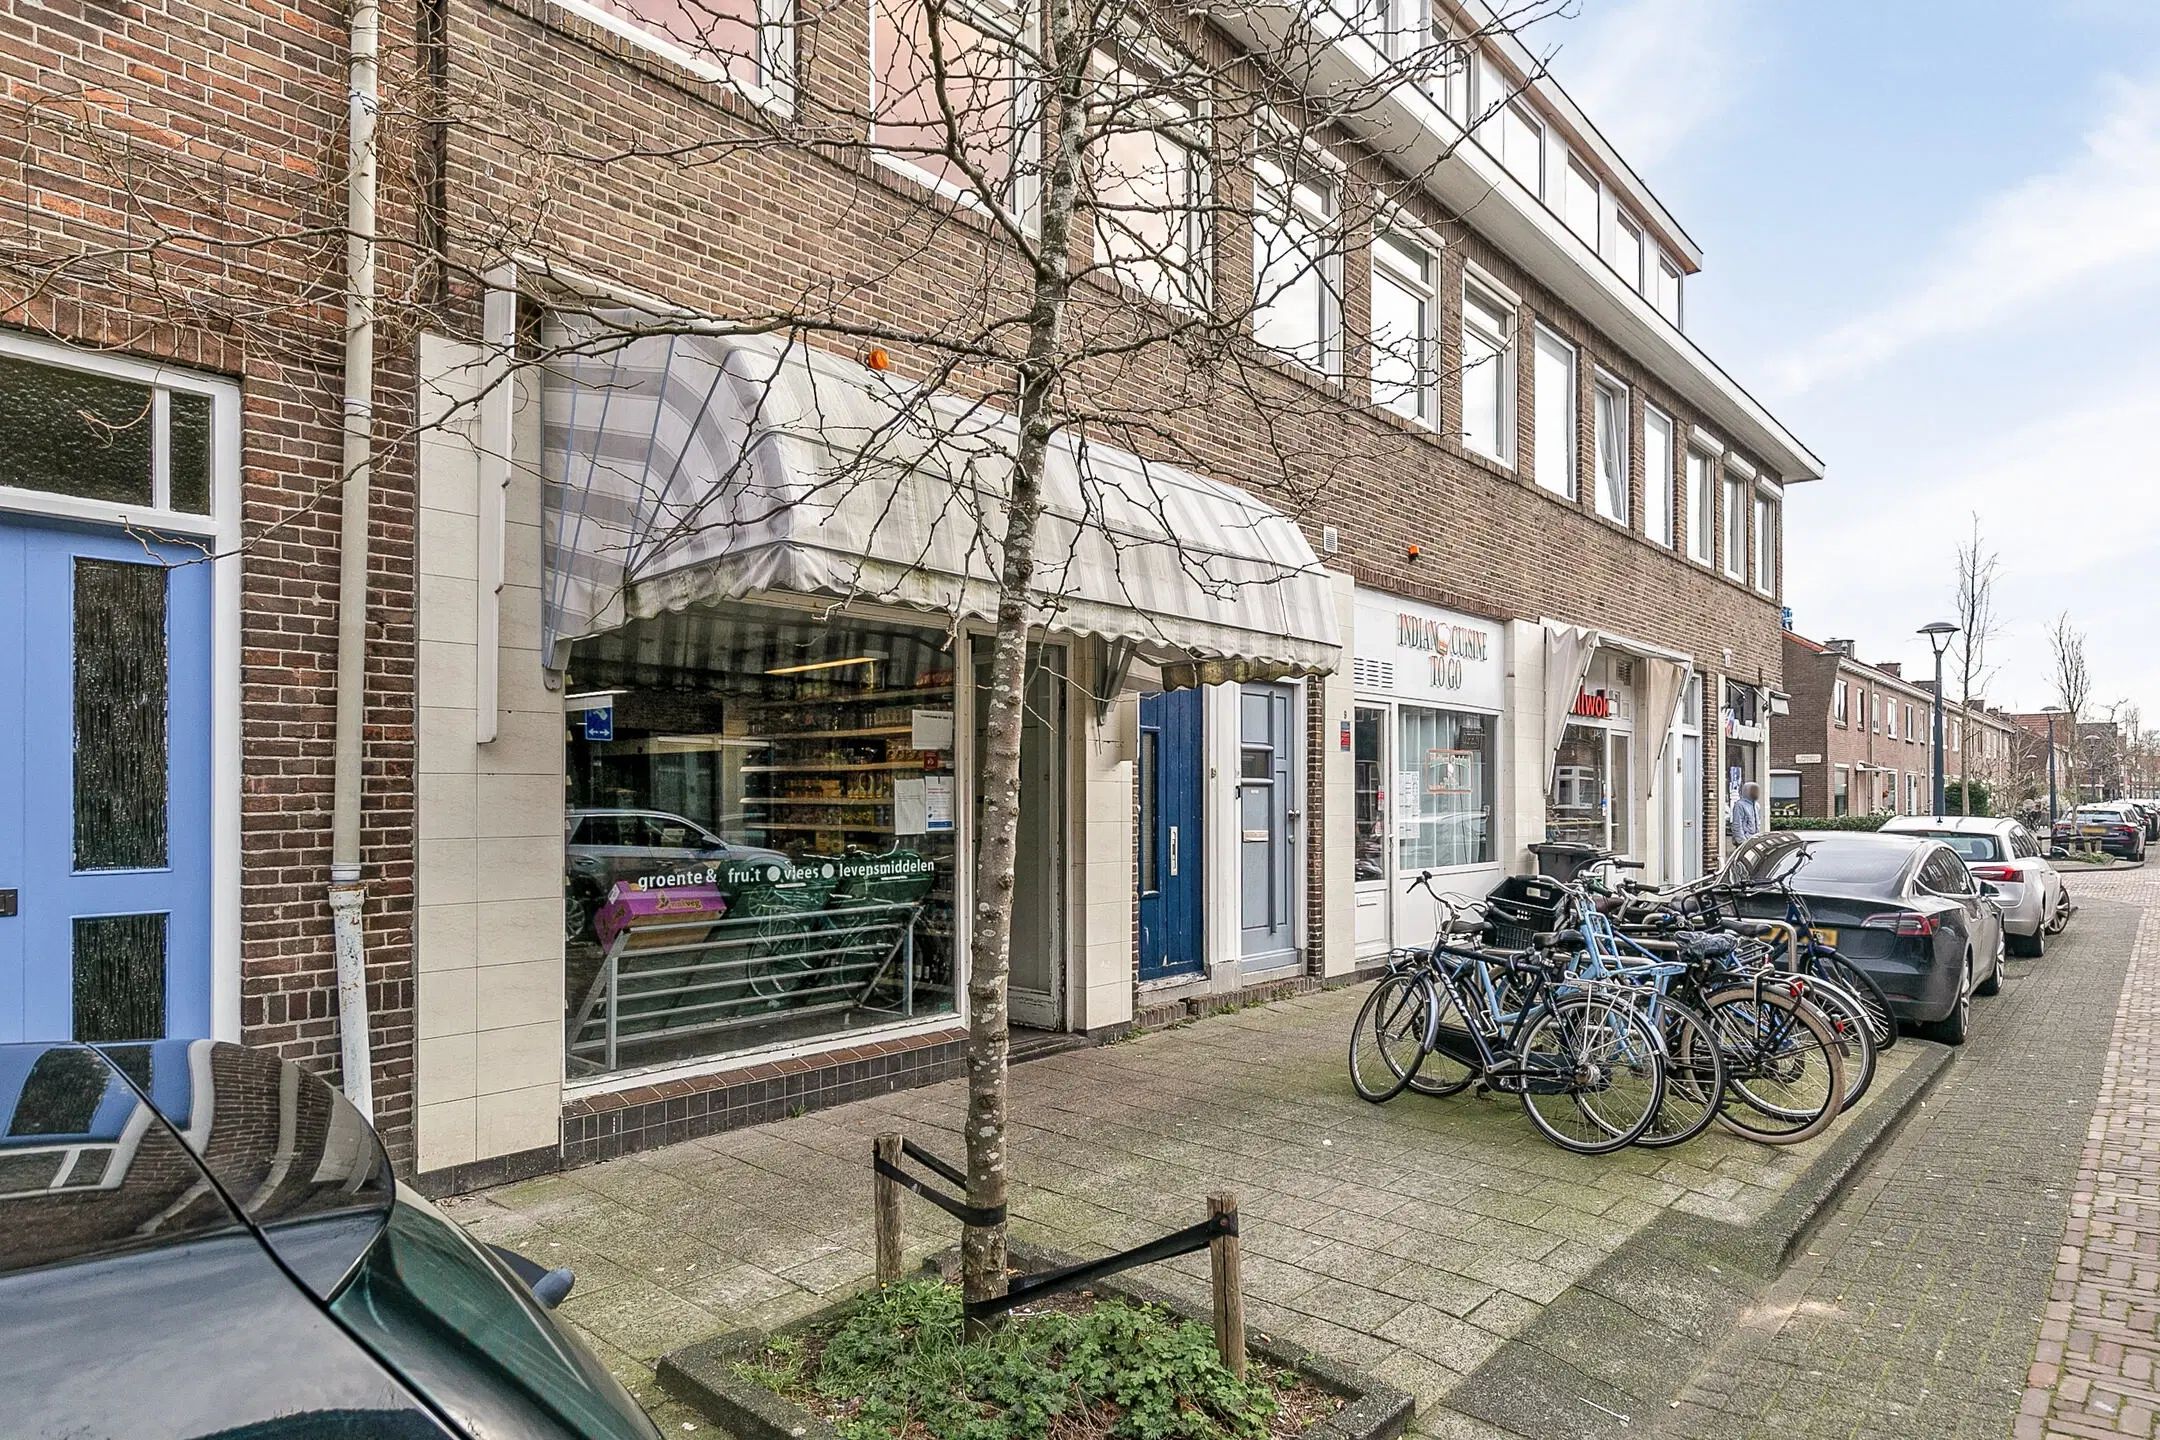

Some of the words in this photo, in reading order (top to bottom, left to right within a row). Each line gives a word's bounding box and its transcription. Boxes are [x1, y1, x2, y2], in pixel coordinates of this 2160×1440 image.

[1398, 613, 1439, 651] INDIAN
[1450, 625, 1487, 661] CUISINE
[1430, 655, 1445, 687] TO
[1447, 658, 1462, 690] GO
[638, 870, 702, 892] groente
[705, 868, 717, 883] &
[784, 865, 819, 880] vlees
[839, 859, 935, 877] levensmiddelen
[1441, 973, 1472, 1020] GIANT
